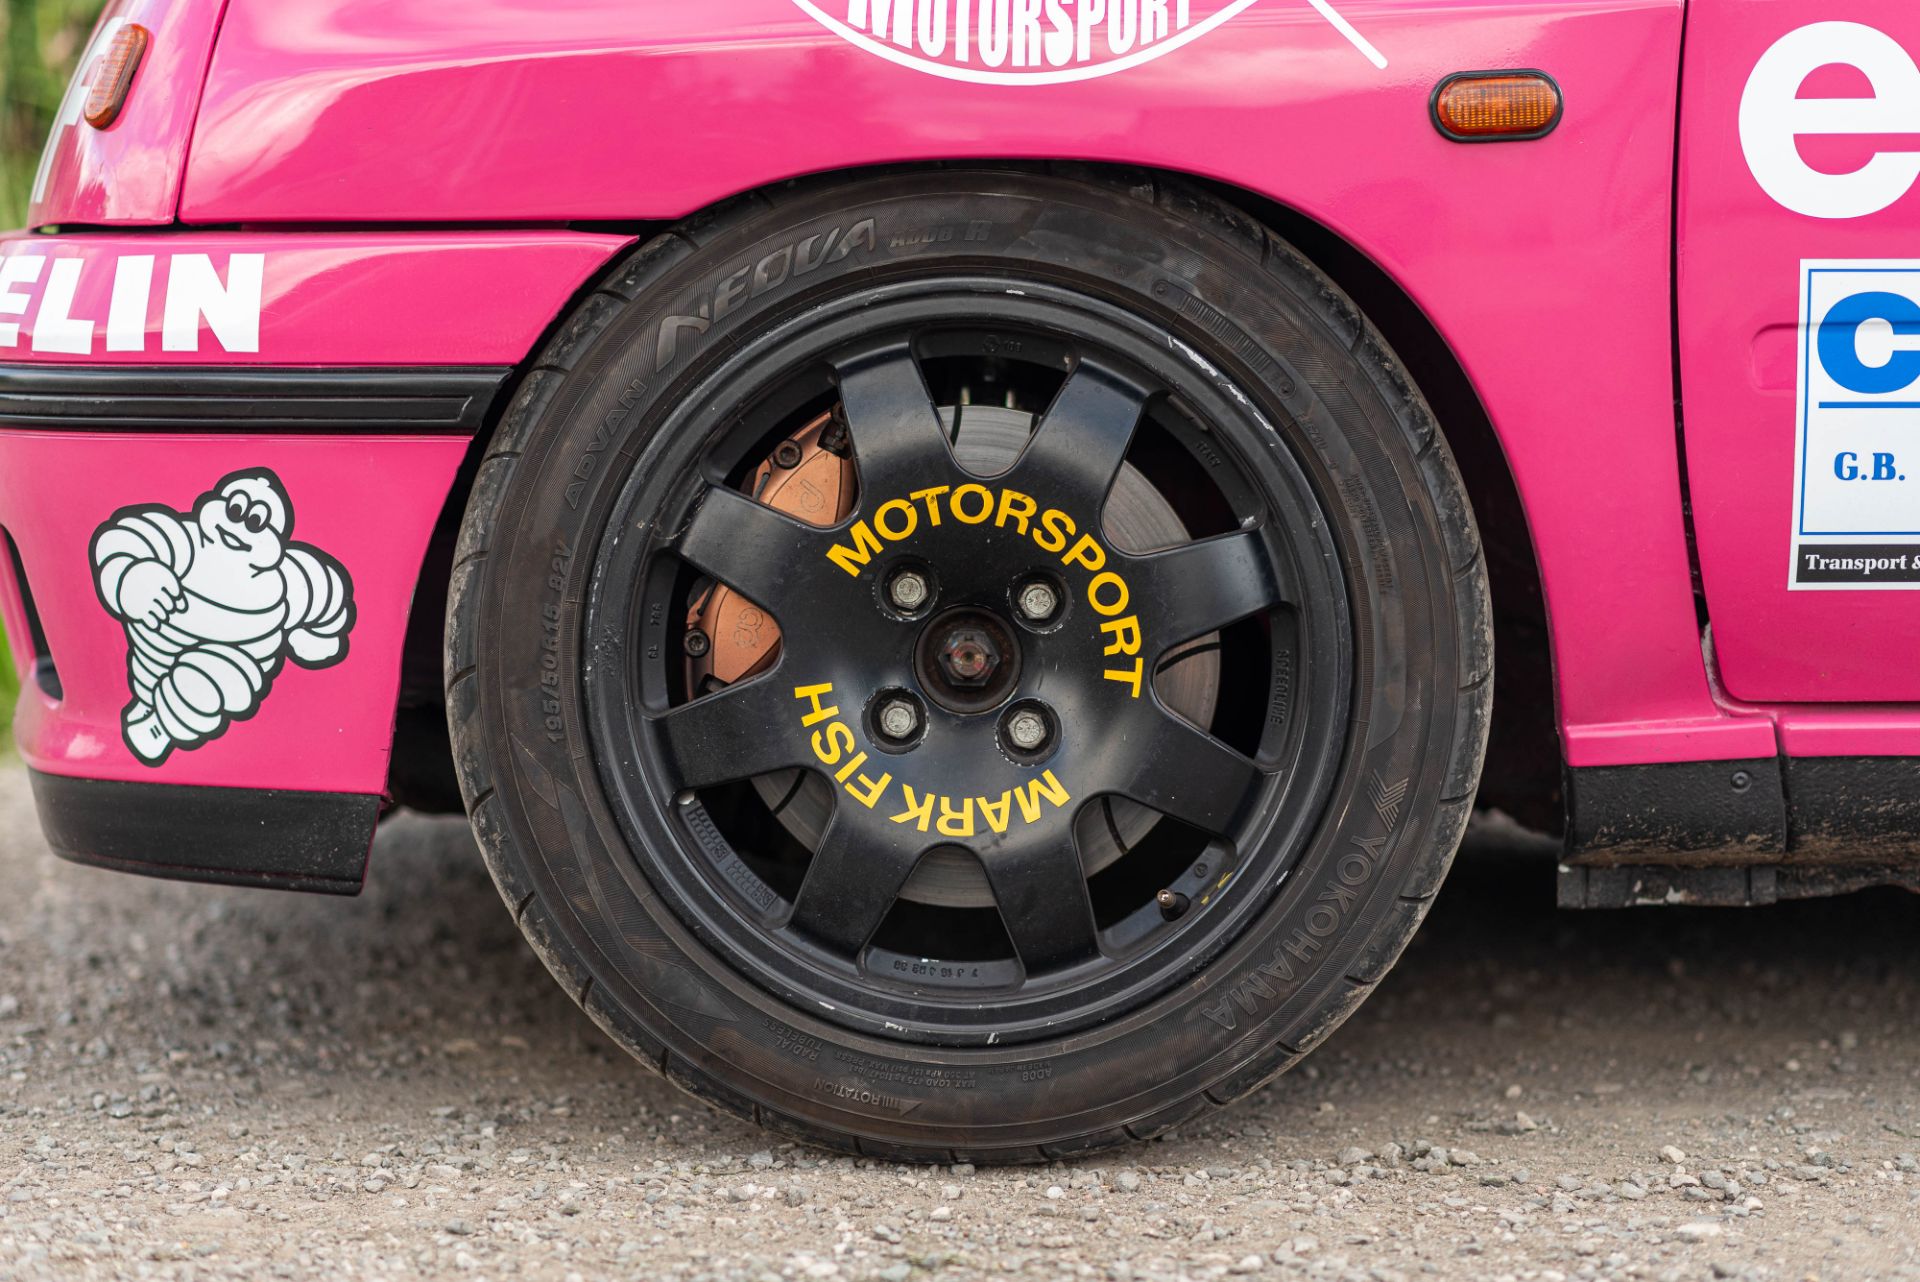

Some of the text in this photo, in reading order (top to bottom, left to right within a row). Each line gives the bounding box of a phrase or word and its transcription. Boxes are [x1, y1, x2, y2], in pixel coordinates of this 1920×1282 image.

[565, 379, 647, 509] ADVAN
[1834, 452, 1906, 481] G.B.
[1805, 554, 1907, 575] Transport
[825, 483, 1144, 698] MOTORSPORT
[540, 603, 563, 743] 195/50R15
[794, 683, 1071, 837] MARK FISH
[1203, 834, 1385, 1031] YOKOHAMA
[762, 1018, 824, 1050] TUBELESS
[773, 1034, 819, 1062] RADIAL
[1021, 1067, 1053, 1081] AD08
[813, 1077, 880, 1105] ROTATION
